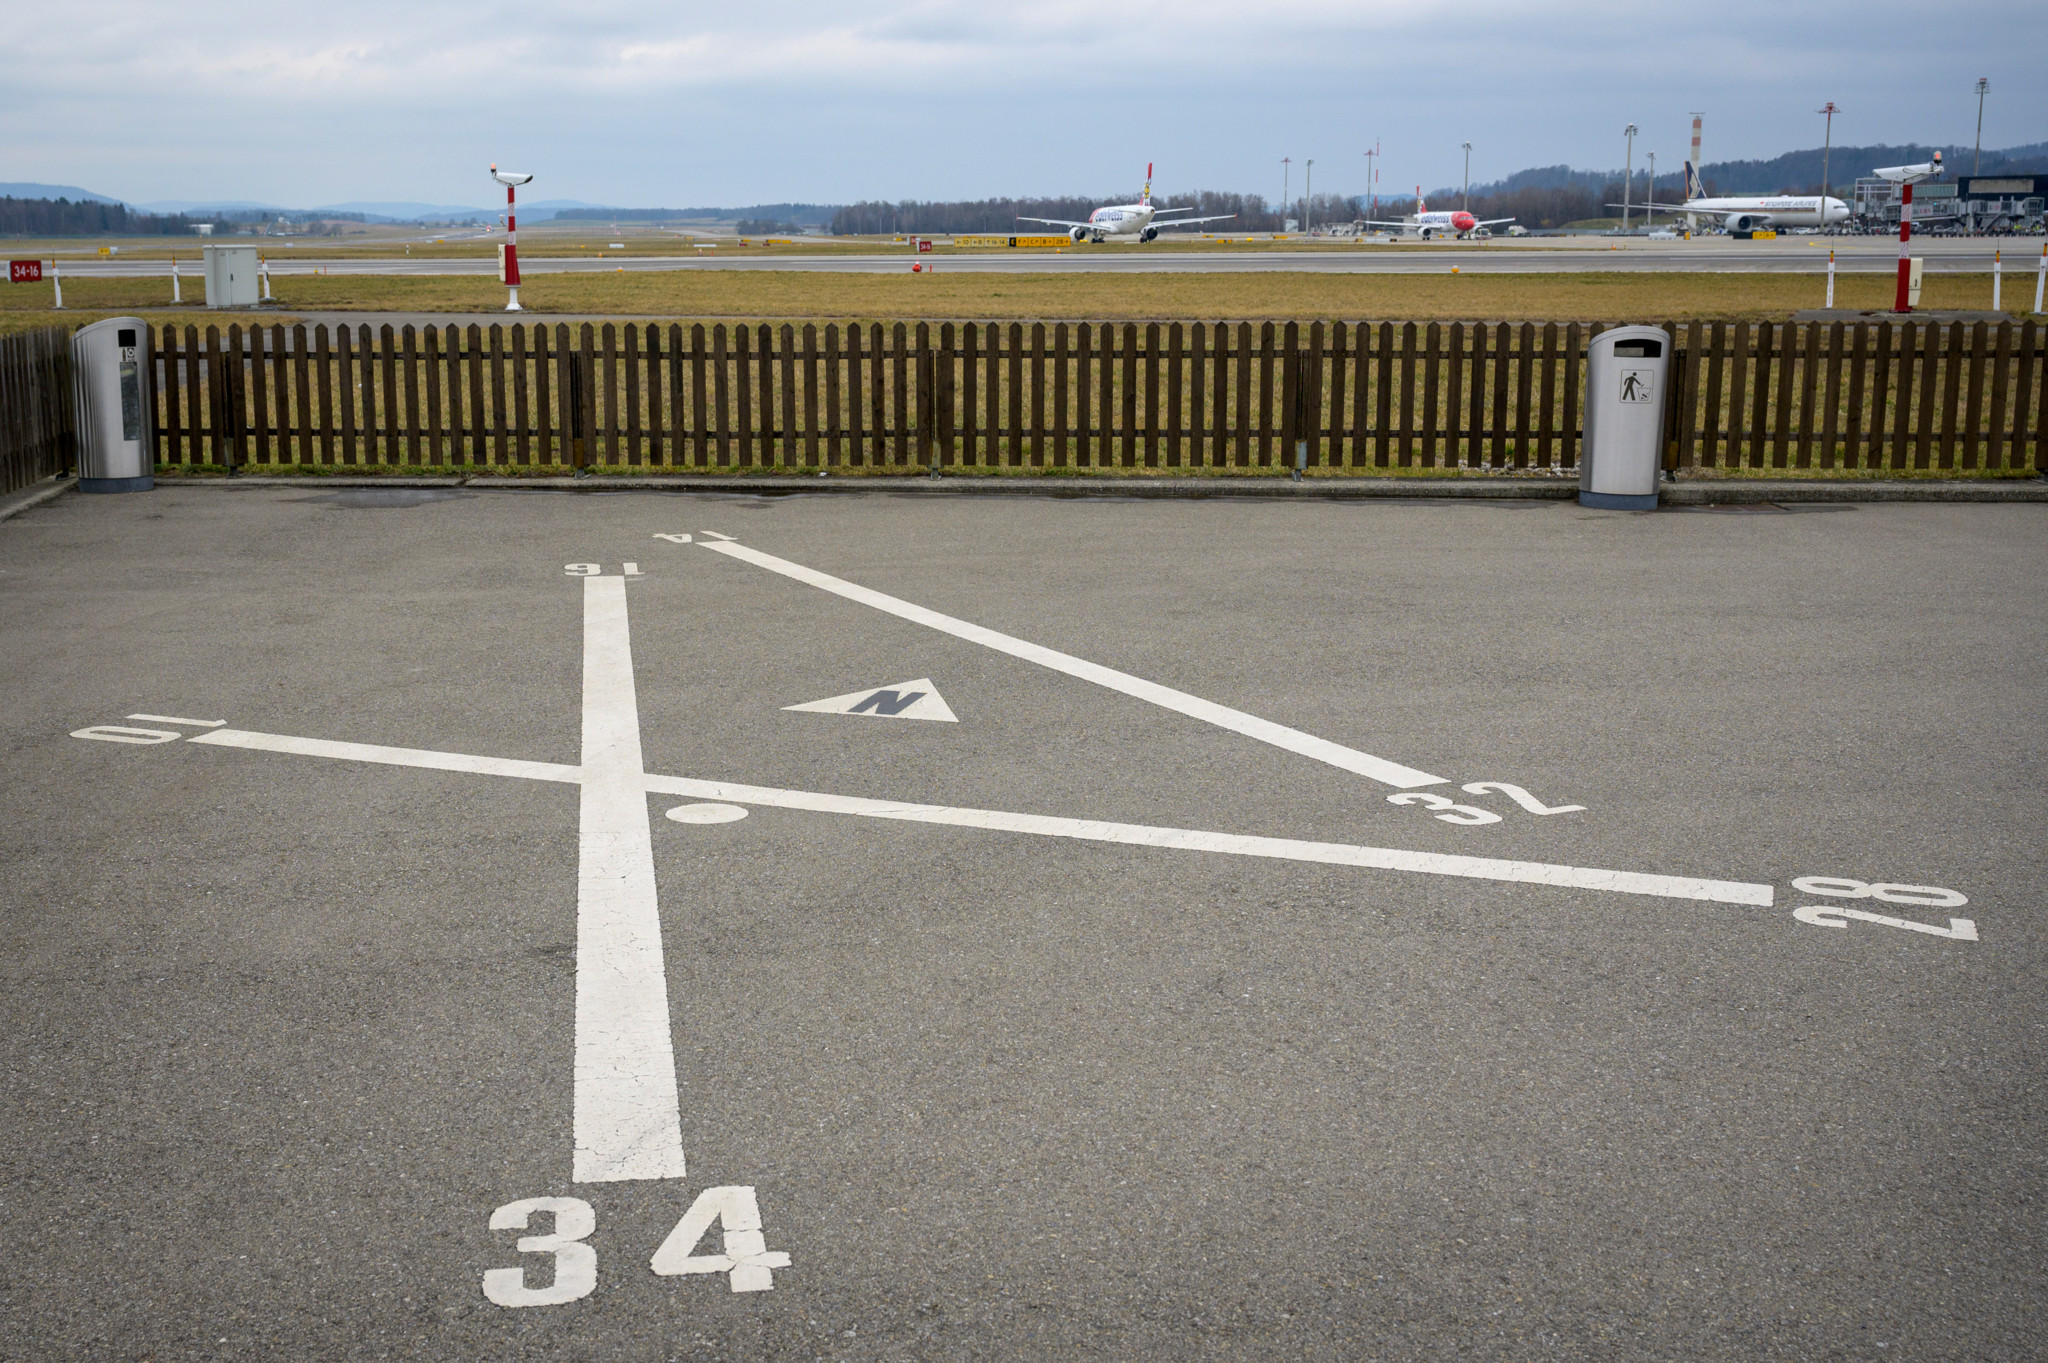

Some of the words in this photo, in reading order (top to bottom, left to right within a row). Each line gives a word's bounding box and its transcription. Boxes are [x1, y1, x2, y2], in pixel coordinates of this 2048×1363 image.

[14, 265, 39, 277] 34-16
[564, 562, 646, 577] 16
[847, 690, 928, 716] N
[69, 713, 228, 745] 10
[1386, 782, 1588, 826] 32
[1791, 876, 1980, 942] 28
[482, 1186, 793, 1308] 34
